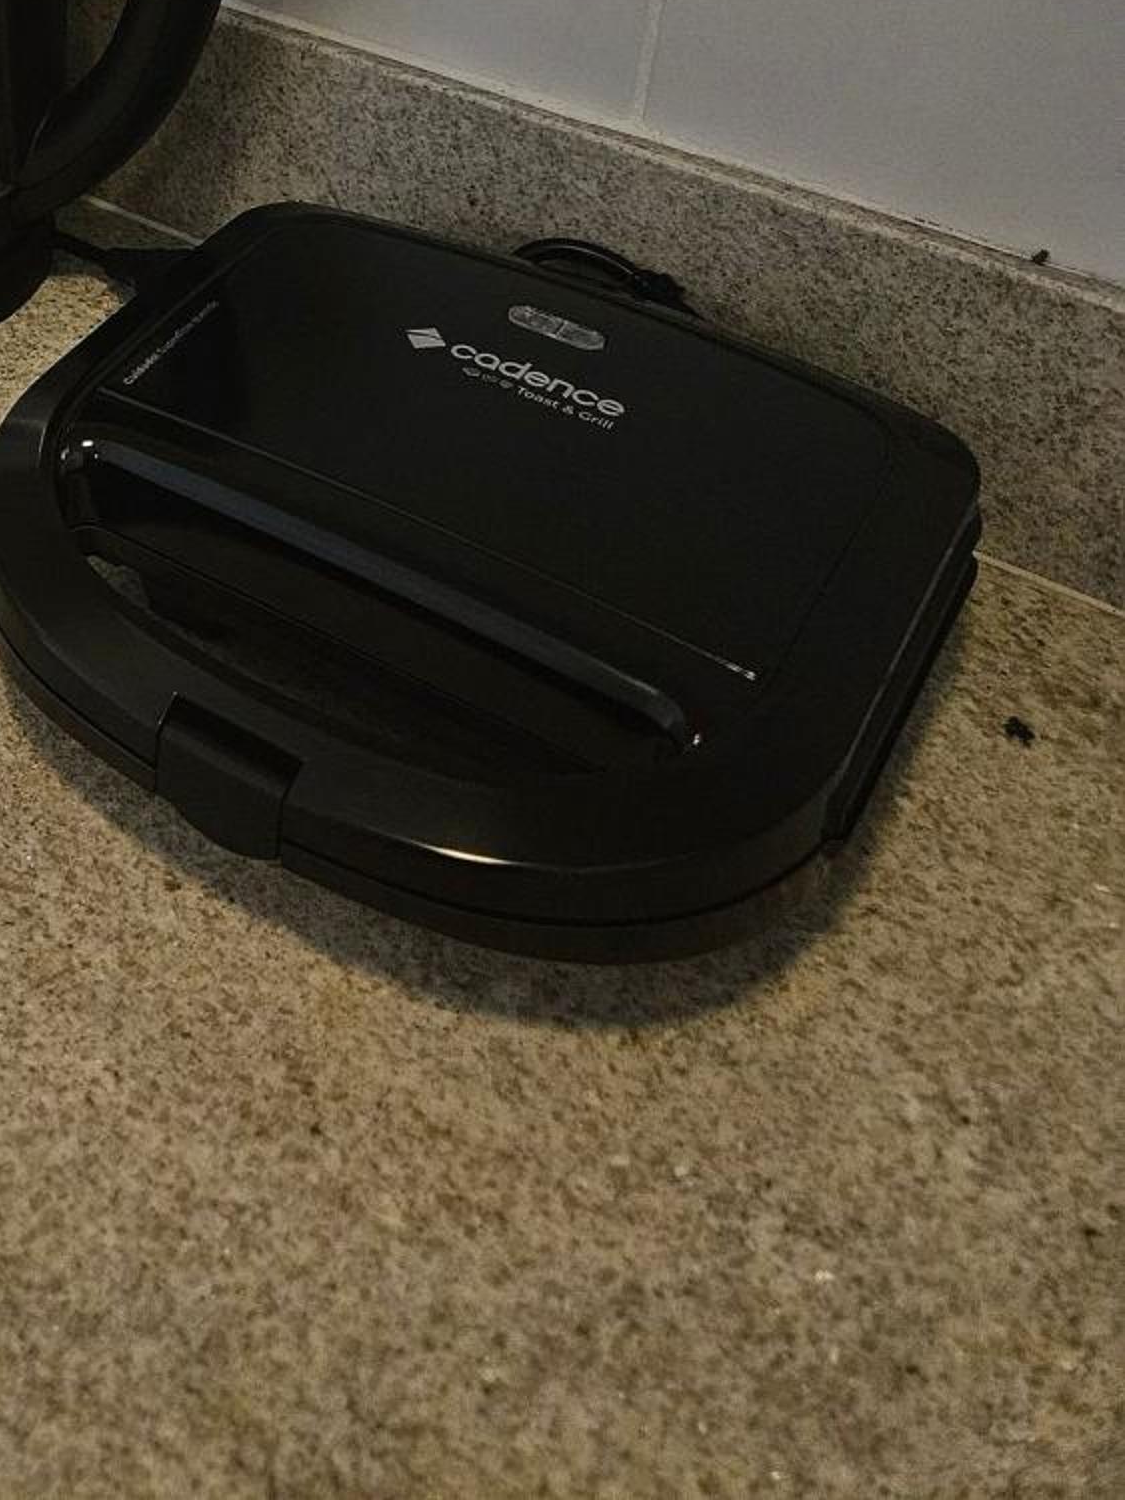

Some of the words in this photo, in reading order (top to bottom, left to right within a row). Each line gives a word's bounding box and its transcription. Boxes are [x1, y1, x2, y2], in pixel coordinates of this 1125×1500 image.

[450, 344, 625, 417] cadence
[517, 386, 559, 410] Toast
[562, 405, 574, 415] &
[579, 411, 614, 430] Grill
